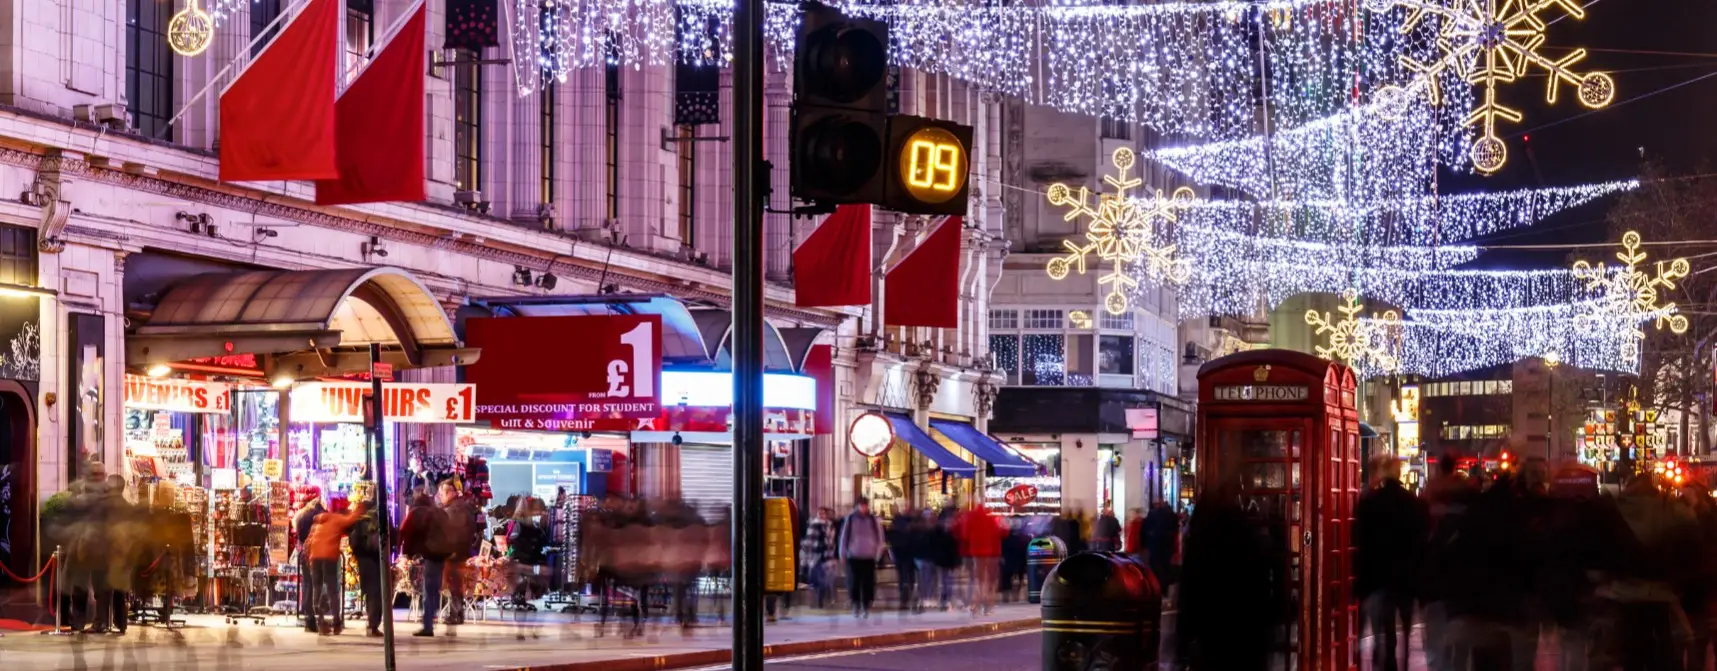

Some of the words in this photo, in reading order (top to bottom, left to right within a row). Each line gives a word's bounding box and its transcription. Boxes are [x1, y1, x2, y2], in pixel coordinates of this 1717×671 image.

[909, 140, 959, 192] 09
[607, 321, 653, 397] £1
[216, 389, 230, 410] £1
[1217, 386, 1307, 399] TELPHONE
[446, 386, 472, 420] £1
[475, 404, 518, 413] SPECIAL
[520, 403, 576, 413] DISCOUNT
[579, 403, 601, 413] FOR
[603, 403, 655, 412] STUDENT
[524, 418, 534, 428] &
[537, 418, 595, 429] Souvenir
[1006, 487, 1036, 503] SALE
